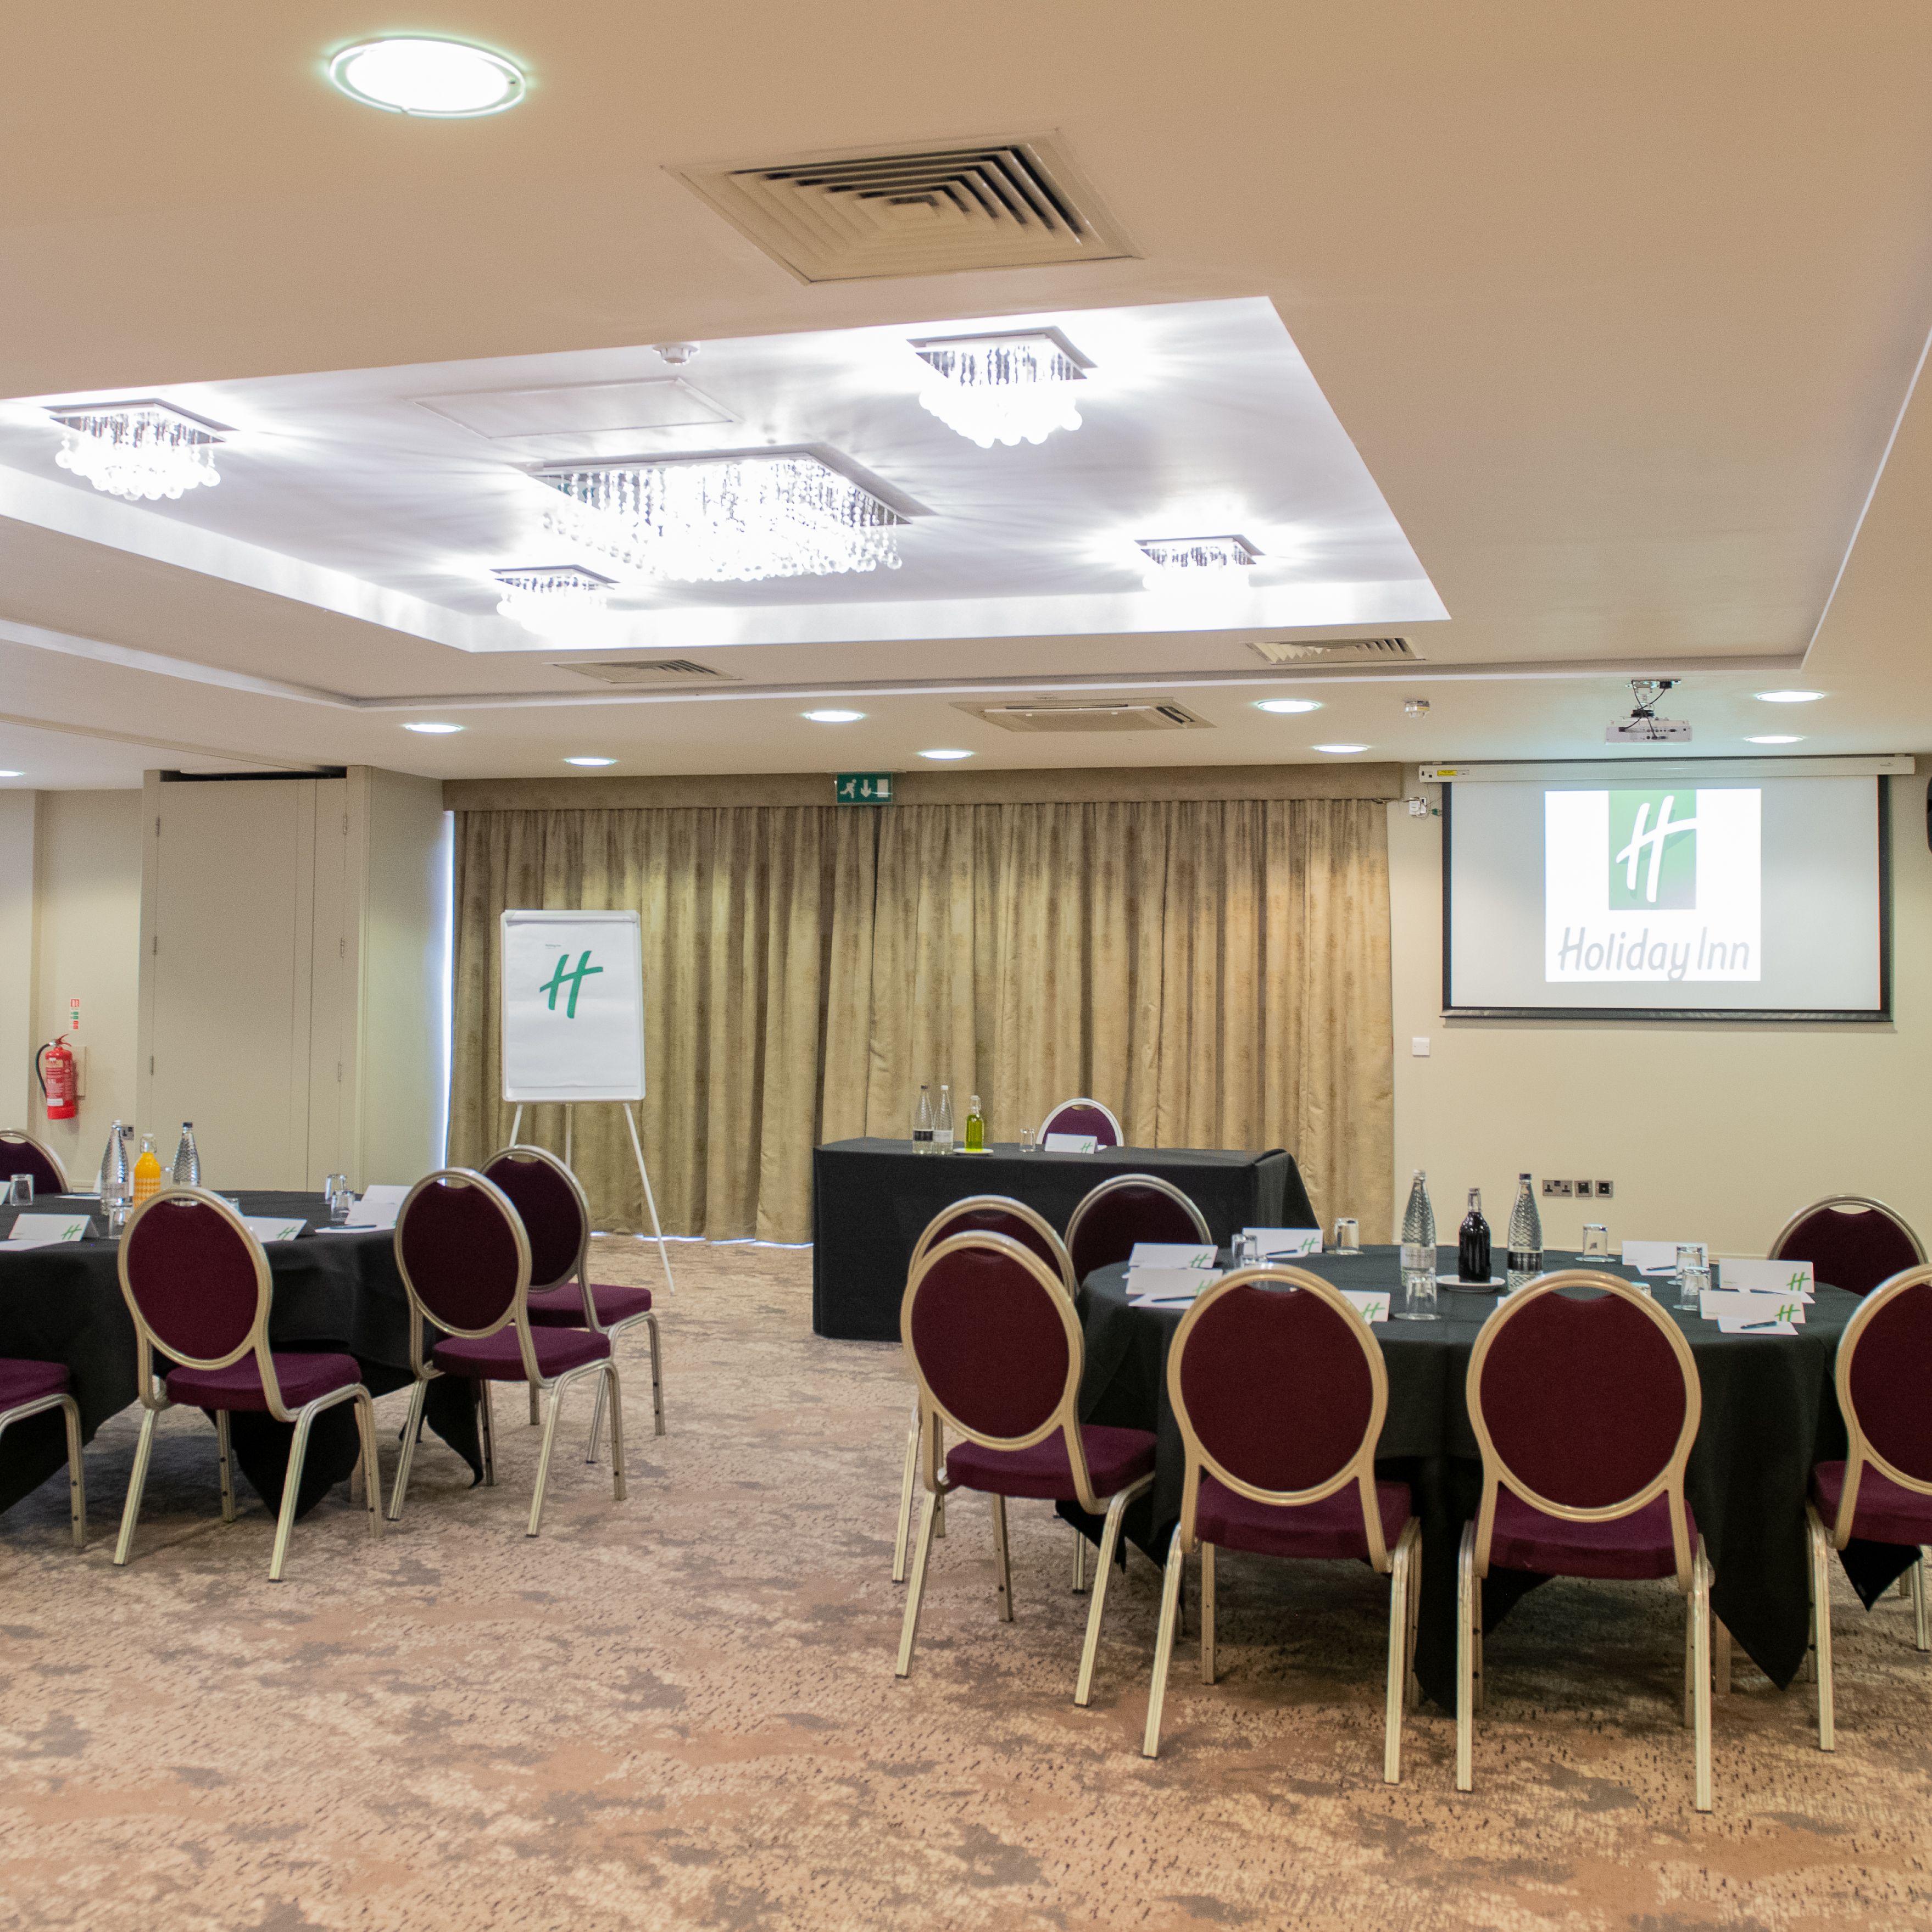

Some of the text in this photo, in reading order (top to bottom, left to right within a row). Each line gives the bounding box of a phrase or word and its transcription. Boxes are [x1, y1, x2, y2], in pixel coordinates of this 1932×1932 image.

[1616, 795, 1697, 903] H
[1558, 926, 1750, 981] Holiday Inn
[539, 950, 603, 1019] H
[1786, 1272, 1811, 1291] H
[1775, 1304, 1801, 1322] H
